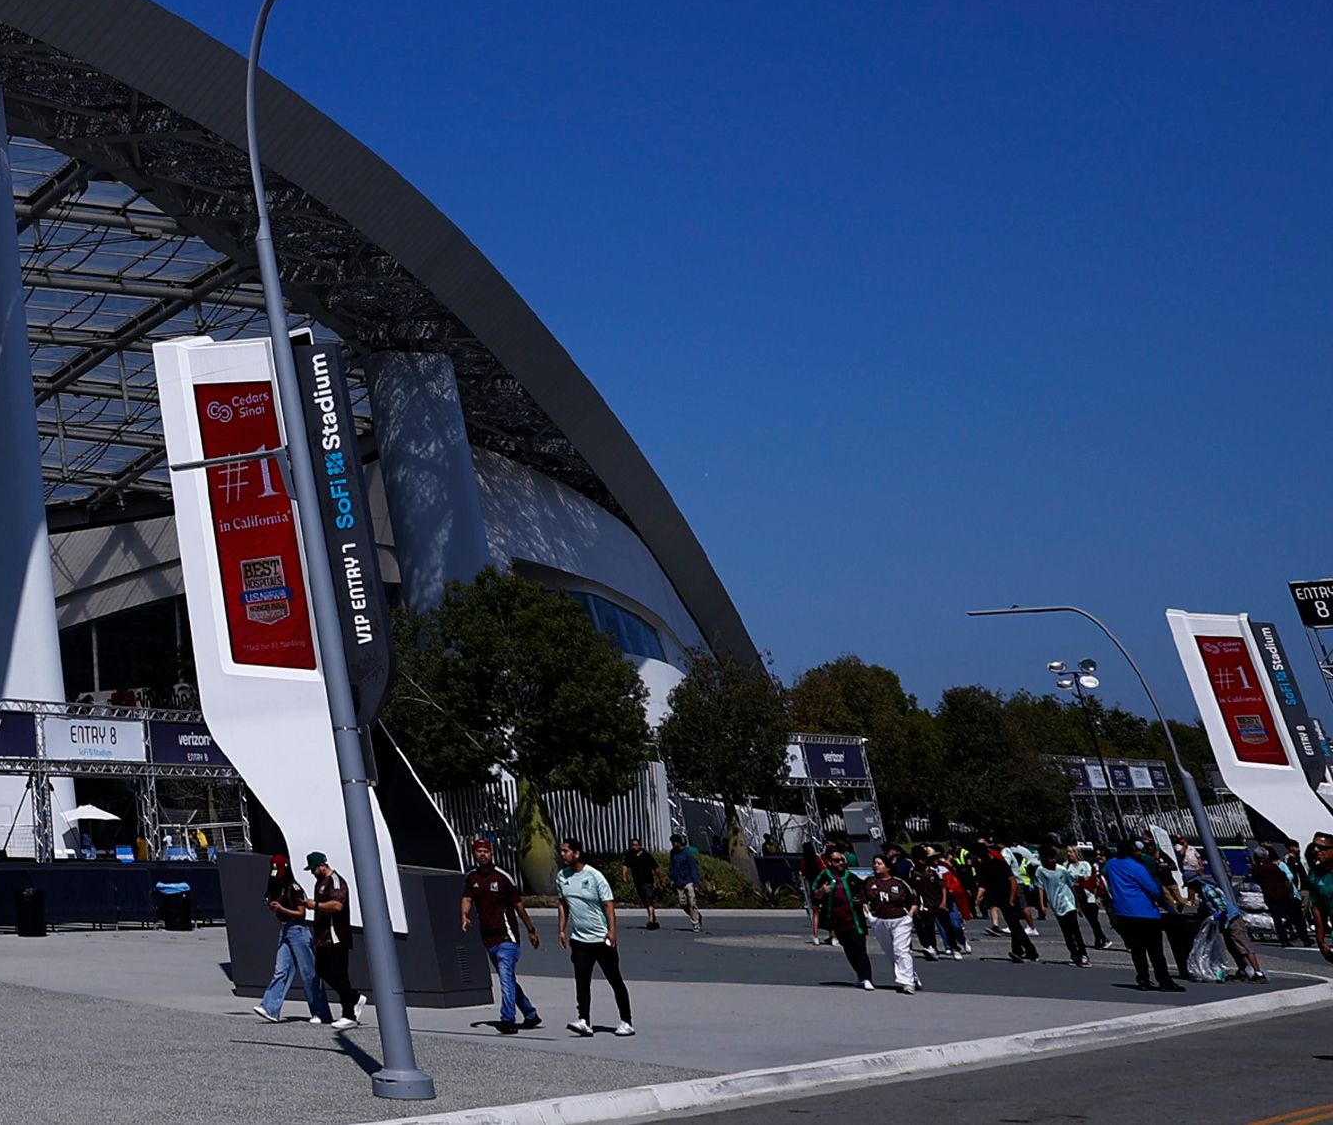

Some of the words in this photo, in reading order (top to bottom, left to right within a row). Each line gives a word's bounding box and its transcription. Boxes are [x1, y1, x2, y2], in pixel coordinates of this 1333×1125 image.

[231, 391, 269, 407] Cedars
[239, 403, 265, 418] Sinai
[312, 353, 341, 451] Stadium
[218, 443, 281, 504] #1
[331, 478, 355, 530] SoFi
[219, 520, 231, 532] in
[341, 542, 357, 554] 7
[243, 560, 280, 579] BEST
[343, 557, 366, 610] ENTRY
[1315, 600, 1330, 619] 8
[354, 615, 373, 645] VIP
[1261, 627, 1284, 671] Stadium
[1214, 666, 1253, 690] #1
[1280, 683, 1298, 706] SoFi
[70, 725, 106, 744] ENTRY
[110, 726, 117, 745] 8
[178, 731, 210, 746] verizon
[1298, 732, 1315, 756] ENTRY
